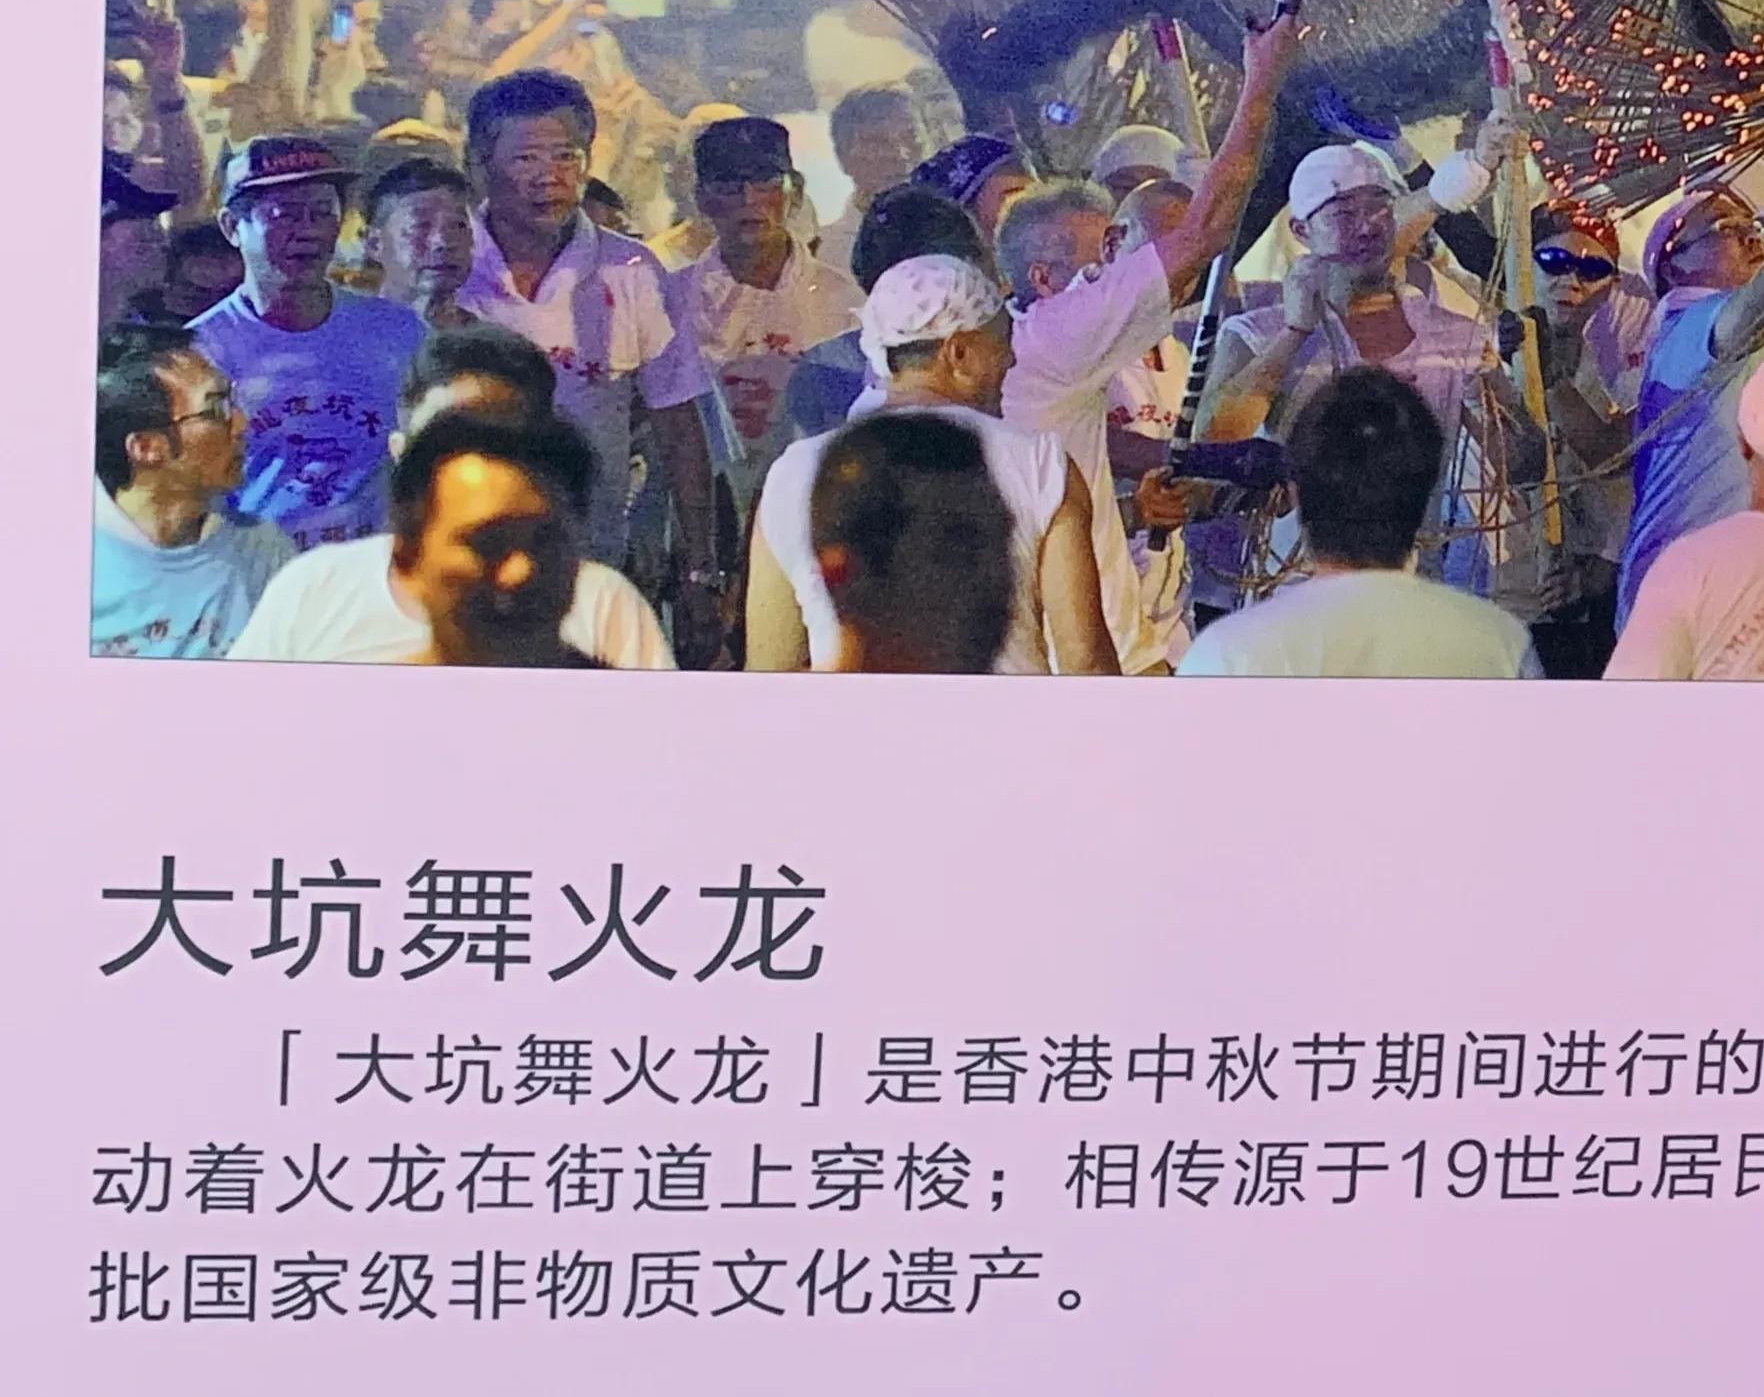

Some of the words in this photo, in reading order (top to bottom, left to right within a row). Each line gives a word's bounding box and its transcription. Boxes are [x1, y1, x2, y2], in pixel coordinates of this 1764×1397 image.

[98, 854, 827, 983] 大坑舞火龙
[88, 1245, 1083, 1324] 批国家级非物质文化遗产。
